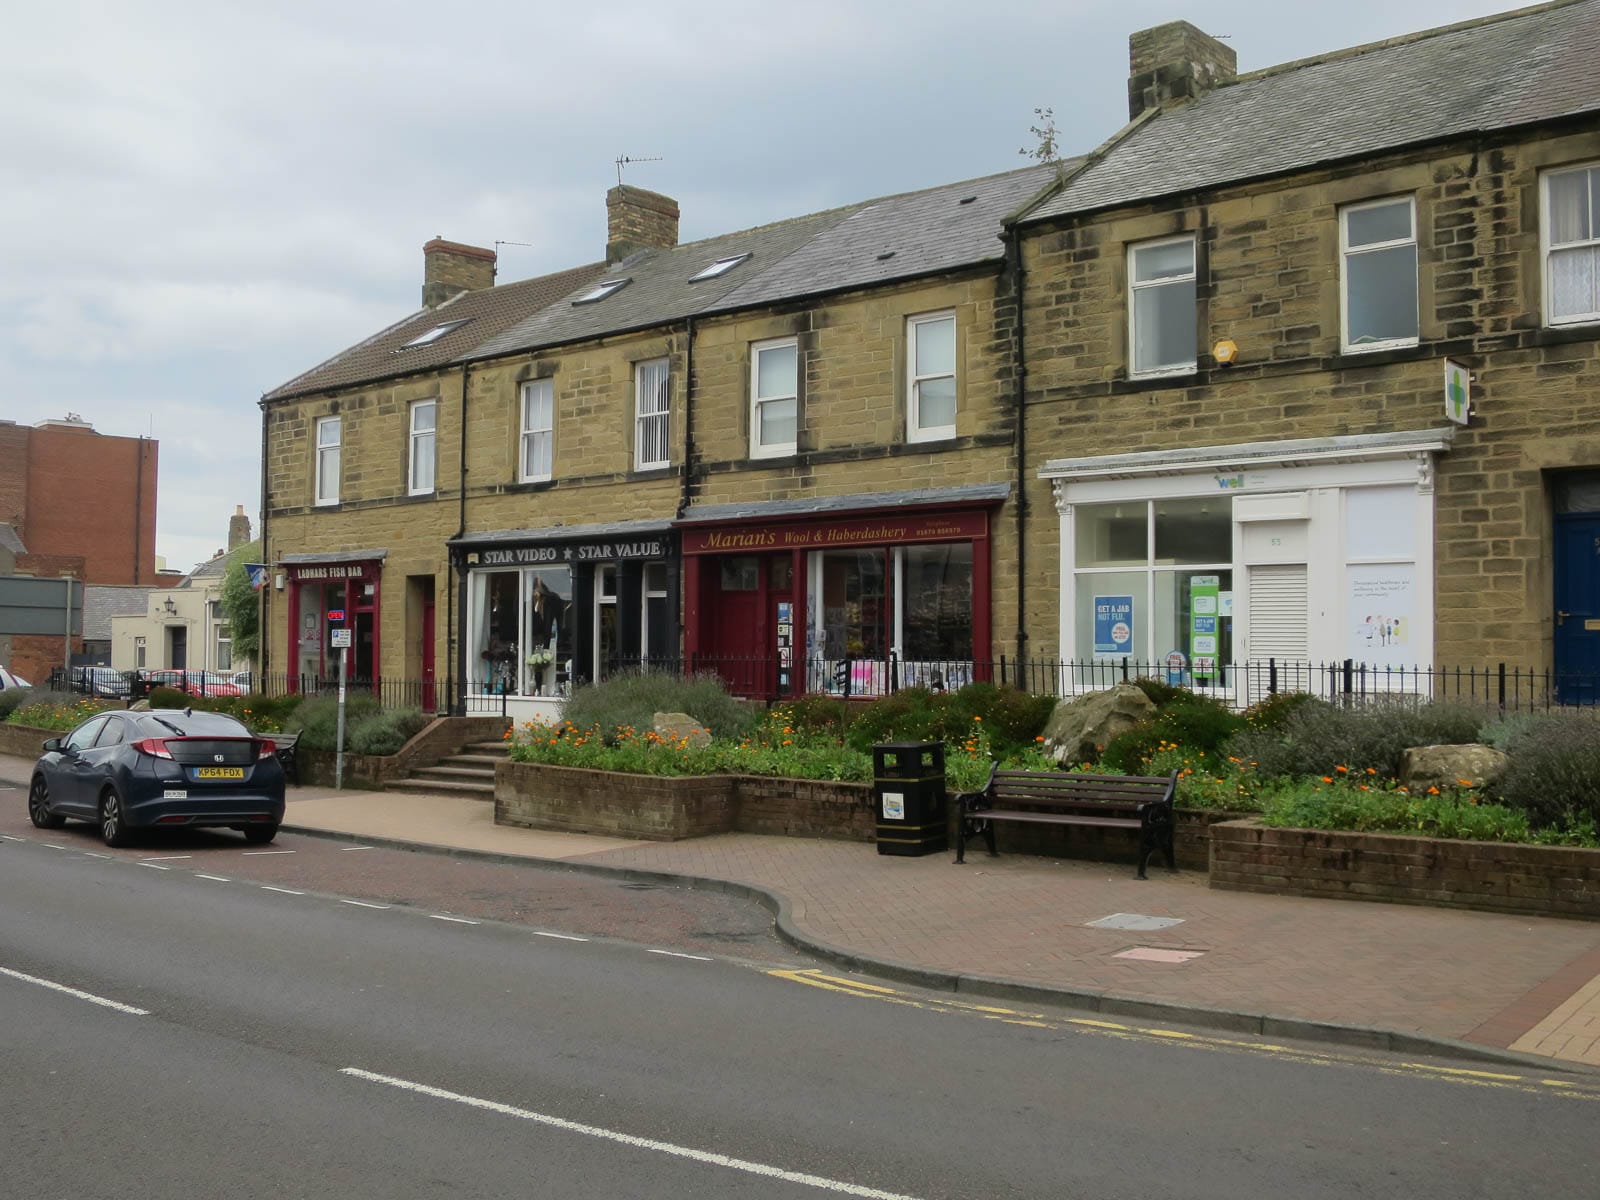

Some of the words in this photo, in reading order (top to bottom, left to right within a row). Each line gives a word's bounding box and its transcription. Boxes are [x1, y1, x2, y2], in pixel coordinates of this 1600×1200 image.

[701, 529, 776, 549] Marian's
[784, 530, 812, 544] Wool
[814, 531, 823, 542] &
[827, 526, 907, 542] Haberdashery
[485, 551, 513, 564] STAR
[516, 548, 557, 563] VIDEO
[579, 546, 612, 559] STAR
[615, 542, 660, 557] VALUE
[329, 567, 346, 577] FISH
[347, 566, 363, 577] BAR
